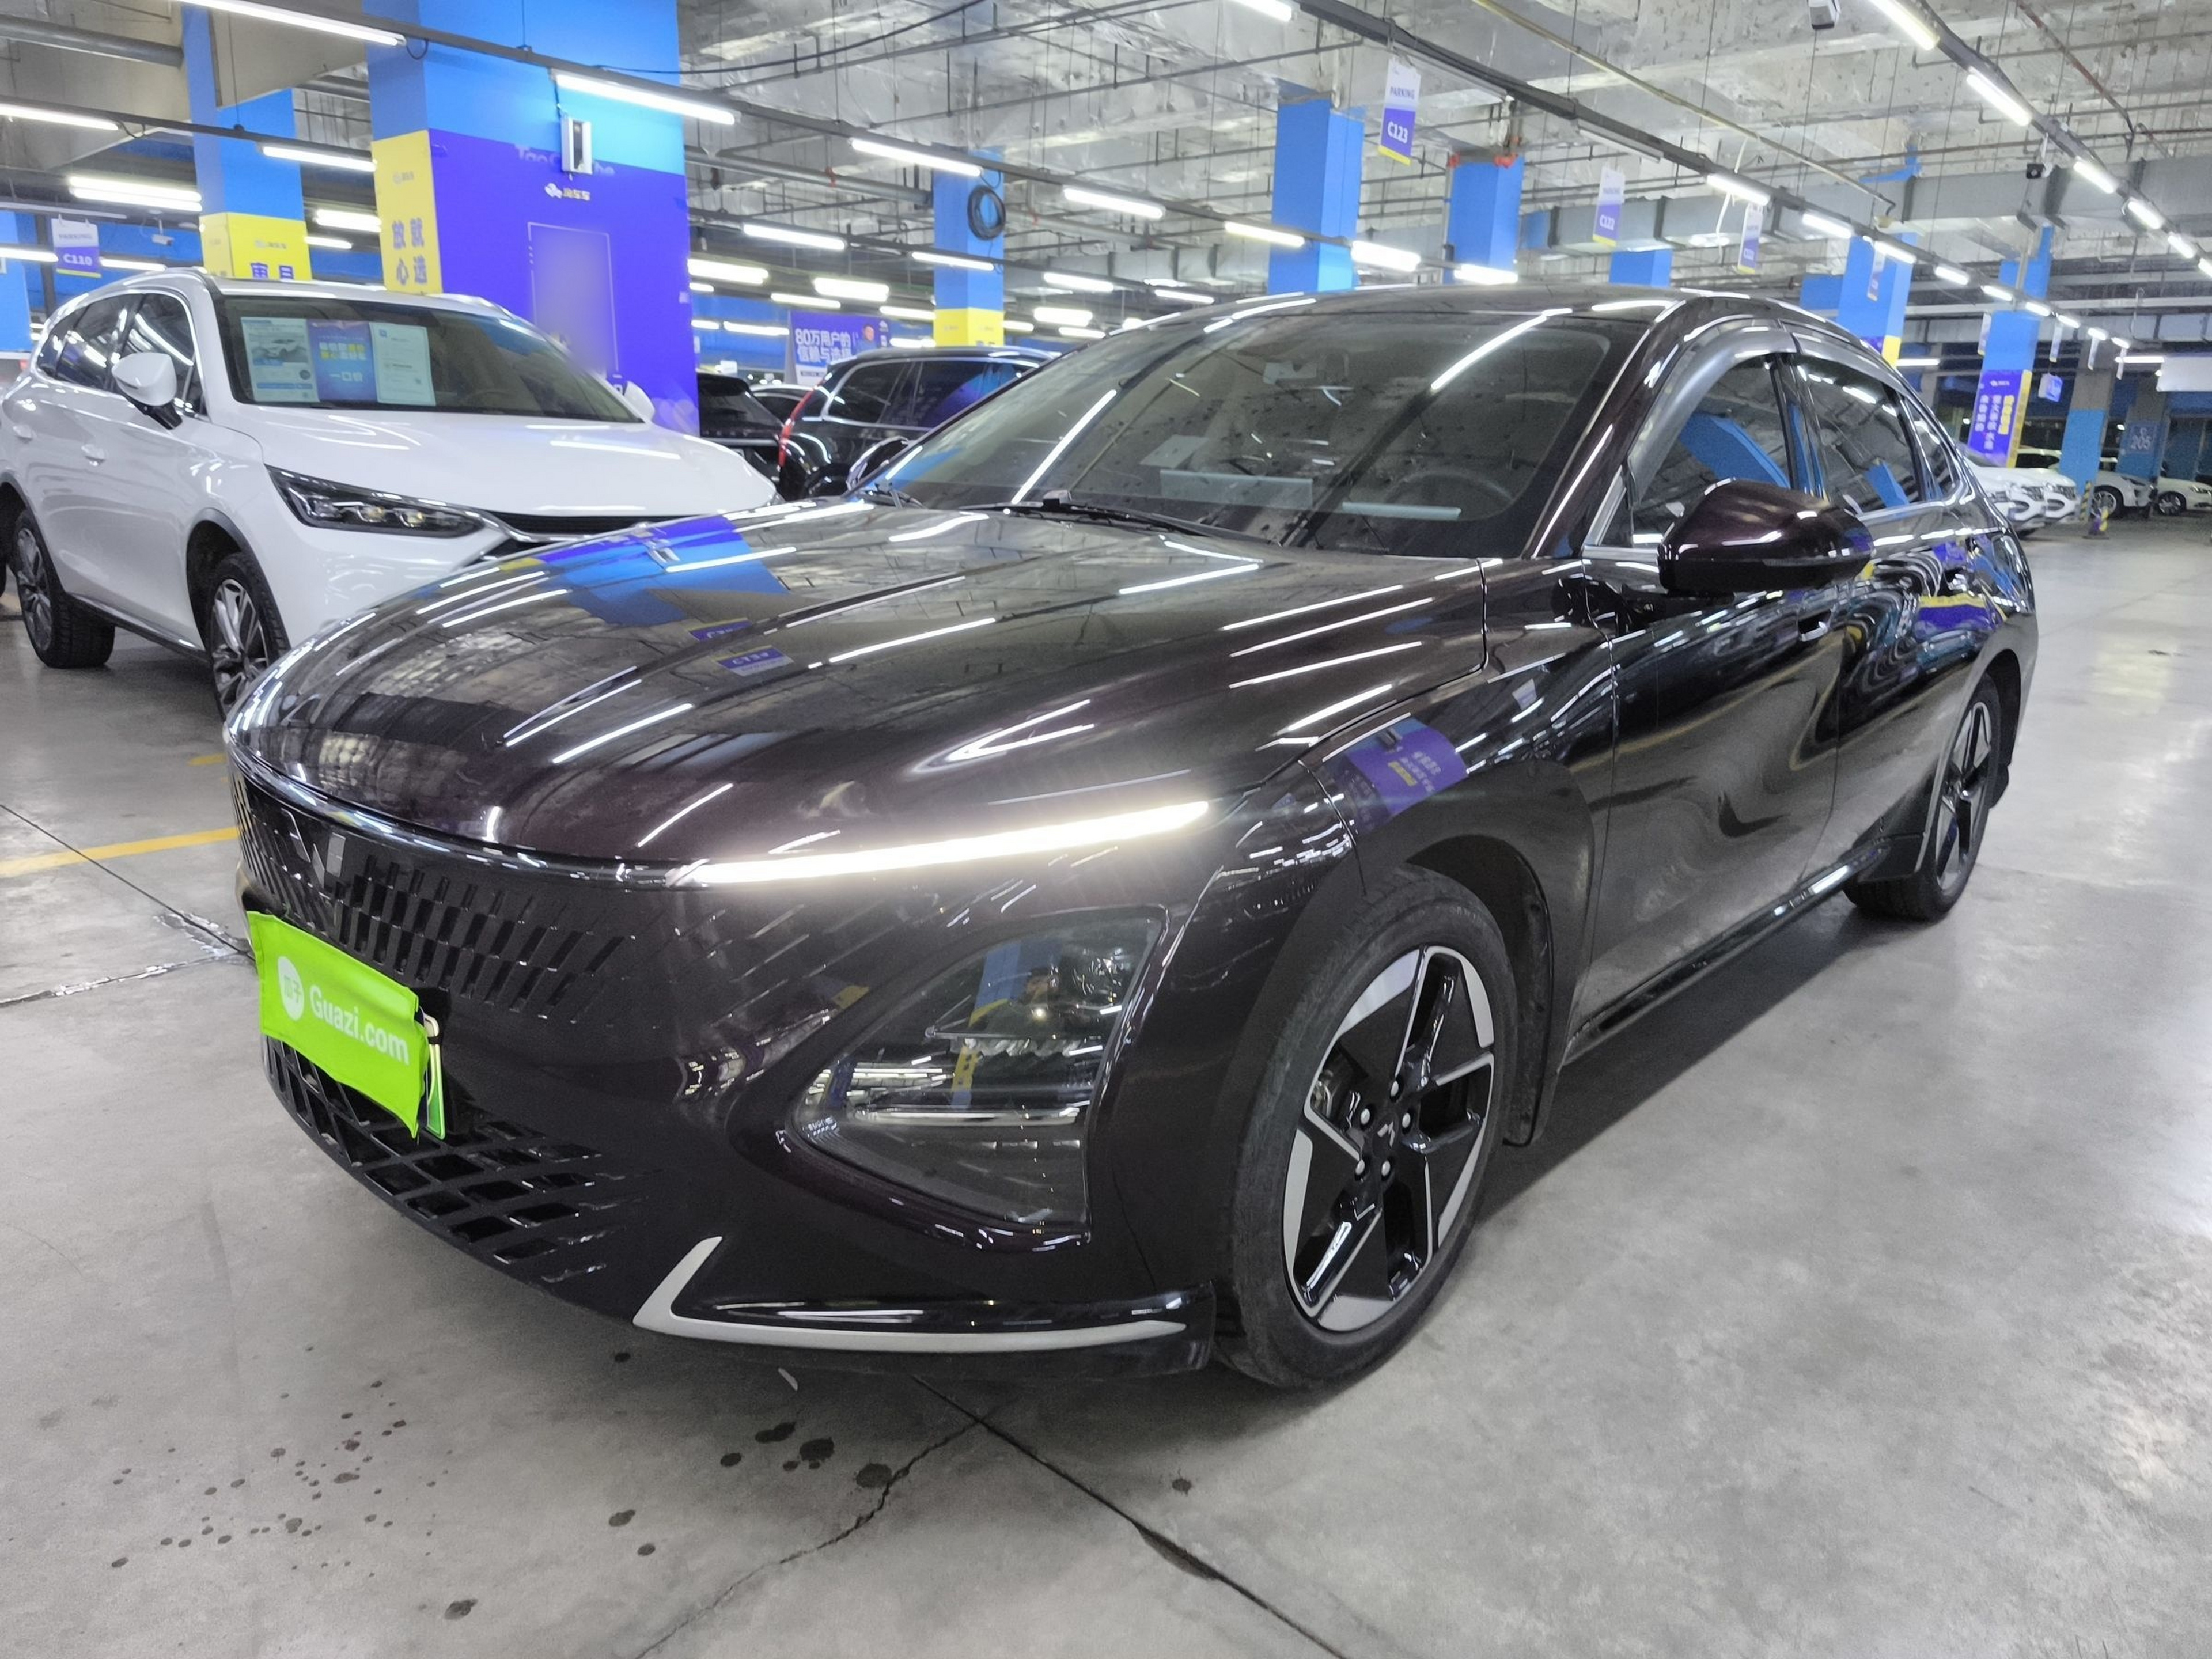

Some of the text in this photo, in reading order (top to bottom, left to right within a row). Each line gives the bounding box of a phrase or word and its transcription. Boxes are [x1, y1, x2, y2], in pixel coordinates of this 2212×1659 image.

[1390, 86, 1415, 100] PARKING
[1387, 121, 1408, 144] C123
[63, 253, 93, 266] C110
[795, 328, 851, 347] 80万用户的
[2131, 434, 2152, 450] 205
[309, 984, 410, 1066] Guazi.com
